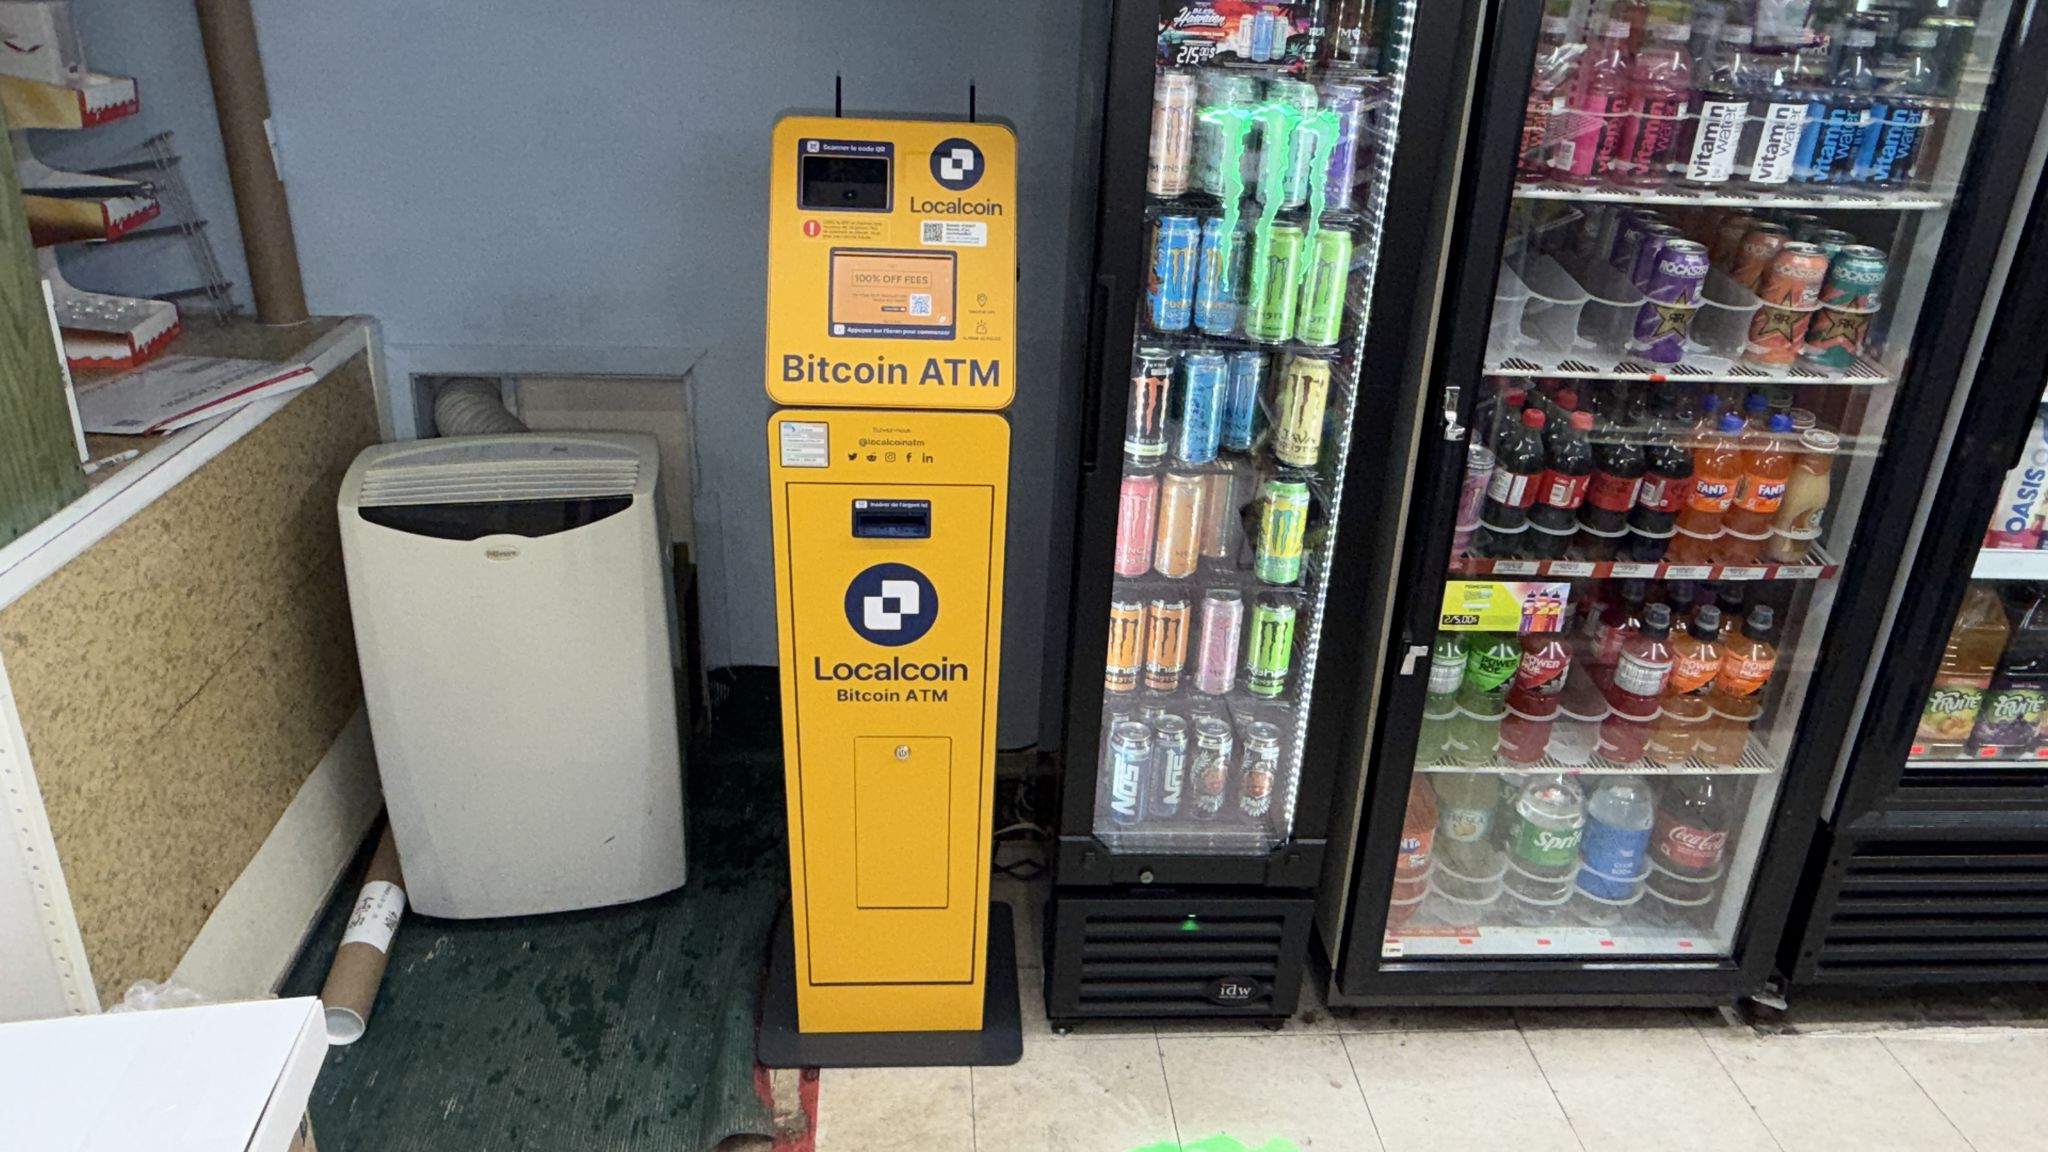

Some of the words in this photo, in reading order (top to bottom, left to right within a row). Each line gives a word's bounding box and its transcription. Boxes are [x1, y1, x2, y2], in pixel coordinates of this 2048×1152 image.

[1694, 105, 1724, 177] vitamin
[1715, 106, 1737, 155] water
[1758, 107, 1790, 179] vitamin
[1780, 108, 1801, 157] water
[1814, 109, 1846, 181] vitamin
[1874, 109, 1908, 181] vitamin
[1896, 110, 1920, 159] water
[910, 197, 1003, 216] Localcoin
[855, 274, 880, 283] 100%
[882, 275, 902, 284] OFF
[904, 276, 928, 285] FEES
[782, 354, 907, 384] Bitcoin
[919, 359, 1000, 387] ATM
[859, 438, 925, 447] @localcoinatm
[1696, 480, 1728, 495] FANTA
[2005, 468, 2046, 535] OASIS
[814, 656, 968, 681] Localcoin
[837, 688, 900, 702] Bitcoin
[905, 689, 948, 702] ATM
[1533, 830, 1582, 852] Sprit
[1220, 983, 1252, 996] idw
